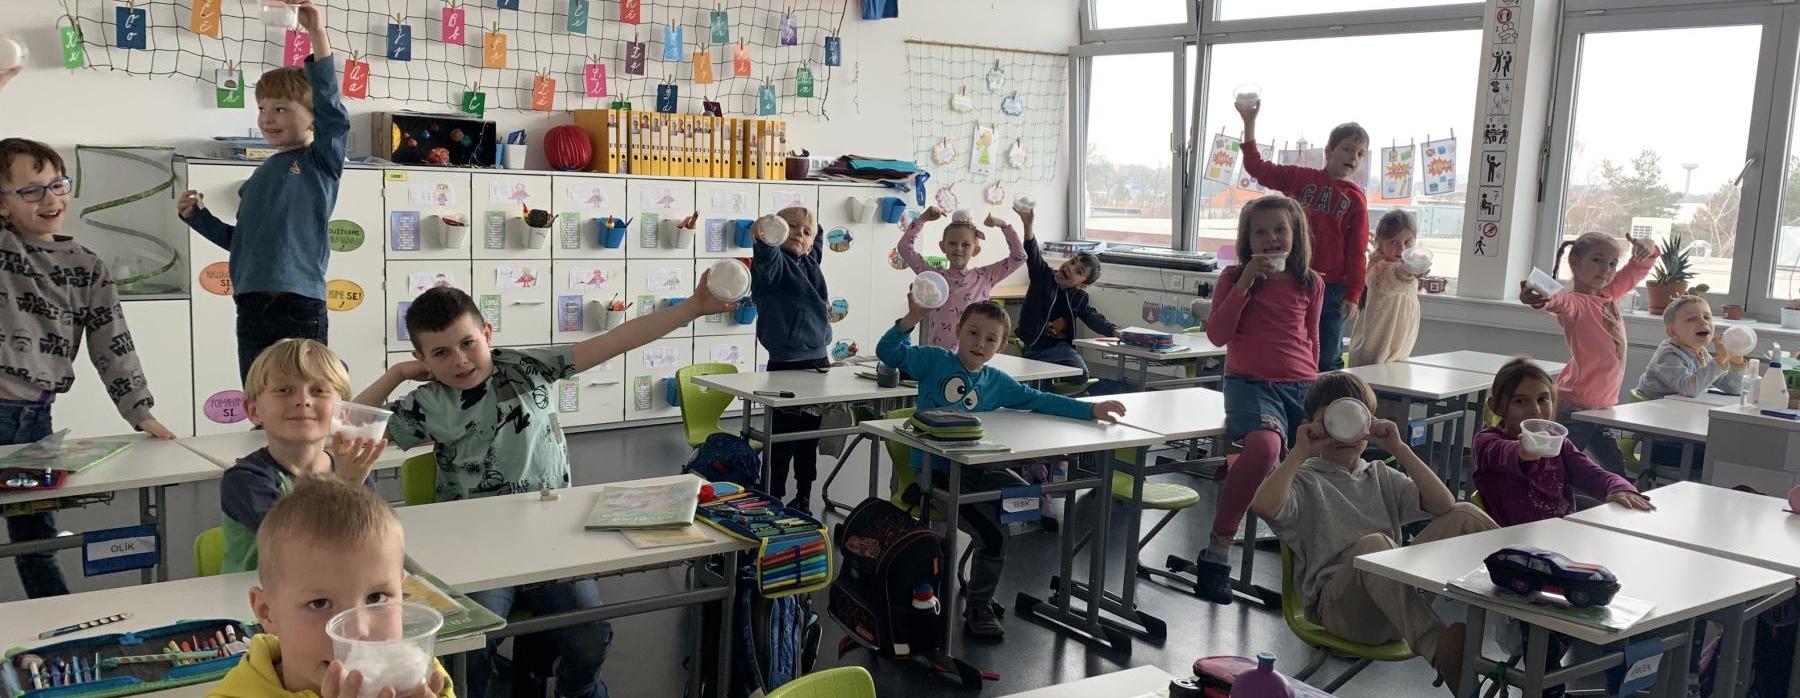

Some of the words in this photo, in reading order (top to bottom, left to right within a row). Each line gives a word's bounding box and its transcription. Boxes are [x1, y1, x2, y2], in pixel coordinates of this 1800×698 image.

[349, 65, 365, 80] A
[348, 82, 364, 92] a
[1302, 184, 1351, 219] GAP
[346, 291, 362, 301] SE!
